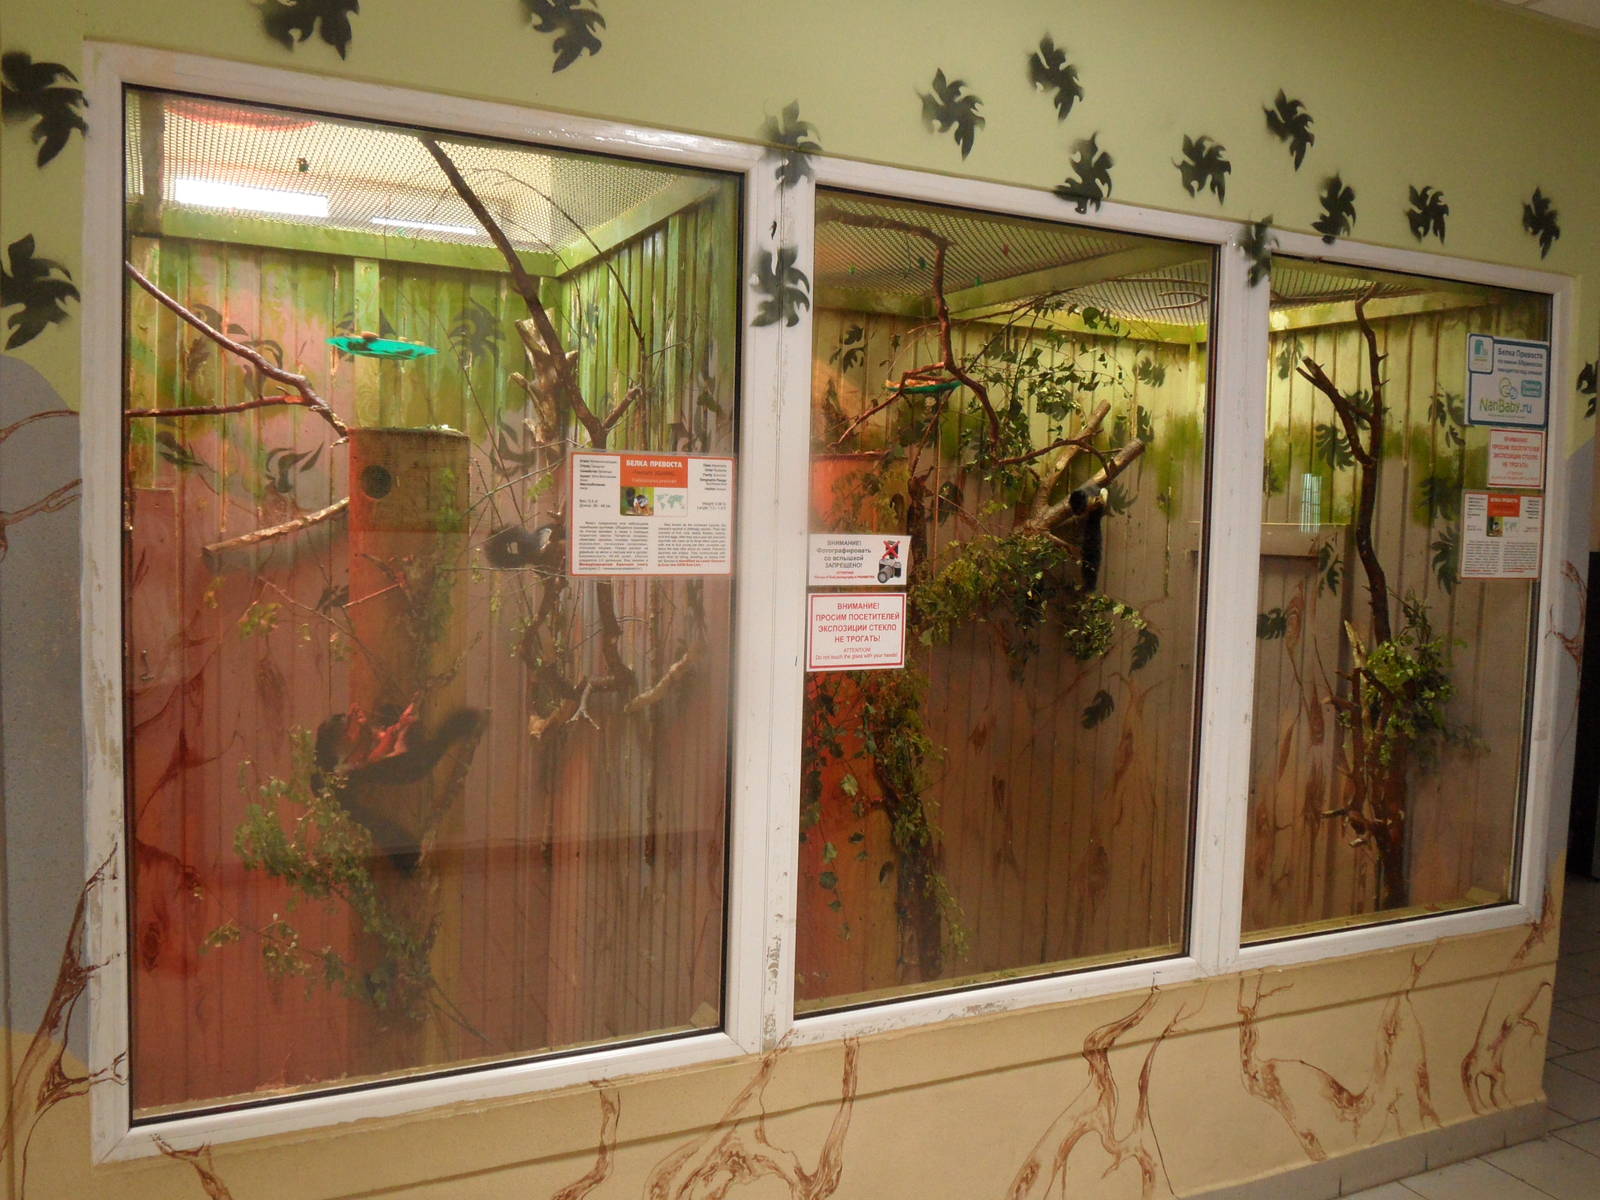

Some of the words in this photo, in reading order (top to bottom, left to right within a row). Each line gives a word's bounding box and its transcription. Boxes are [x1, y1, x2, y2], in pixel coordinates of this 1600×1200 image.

[1479, 396, 1532, 414] NanBaby.ru
[626, 459, 648, 467] БЕЛКА
[650, 460, 683, 468] ПРЕВОСТА
[837, 602, 880, 610] ВНИМАНИЕ!
[815, 613, 847, 621] ПРОСИМ
[848, 611, 900, 621] ПОСЕТИТЕЛЕЙ
[818, 624, 867, 633] ЭКСПОЗИЦИИ
[868, 623, 897, 631] СТЕКЛО
[834, 635, 845, 643] НЕ
[846, 634, 881, 642] ТРОГАТЬ!
